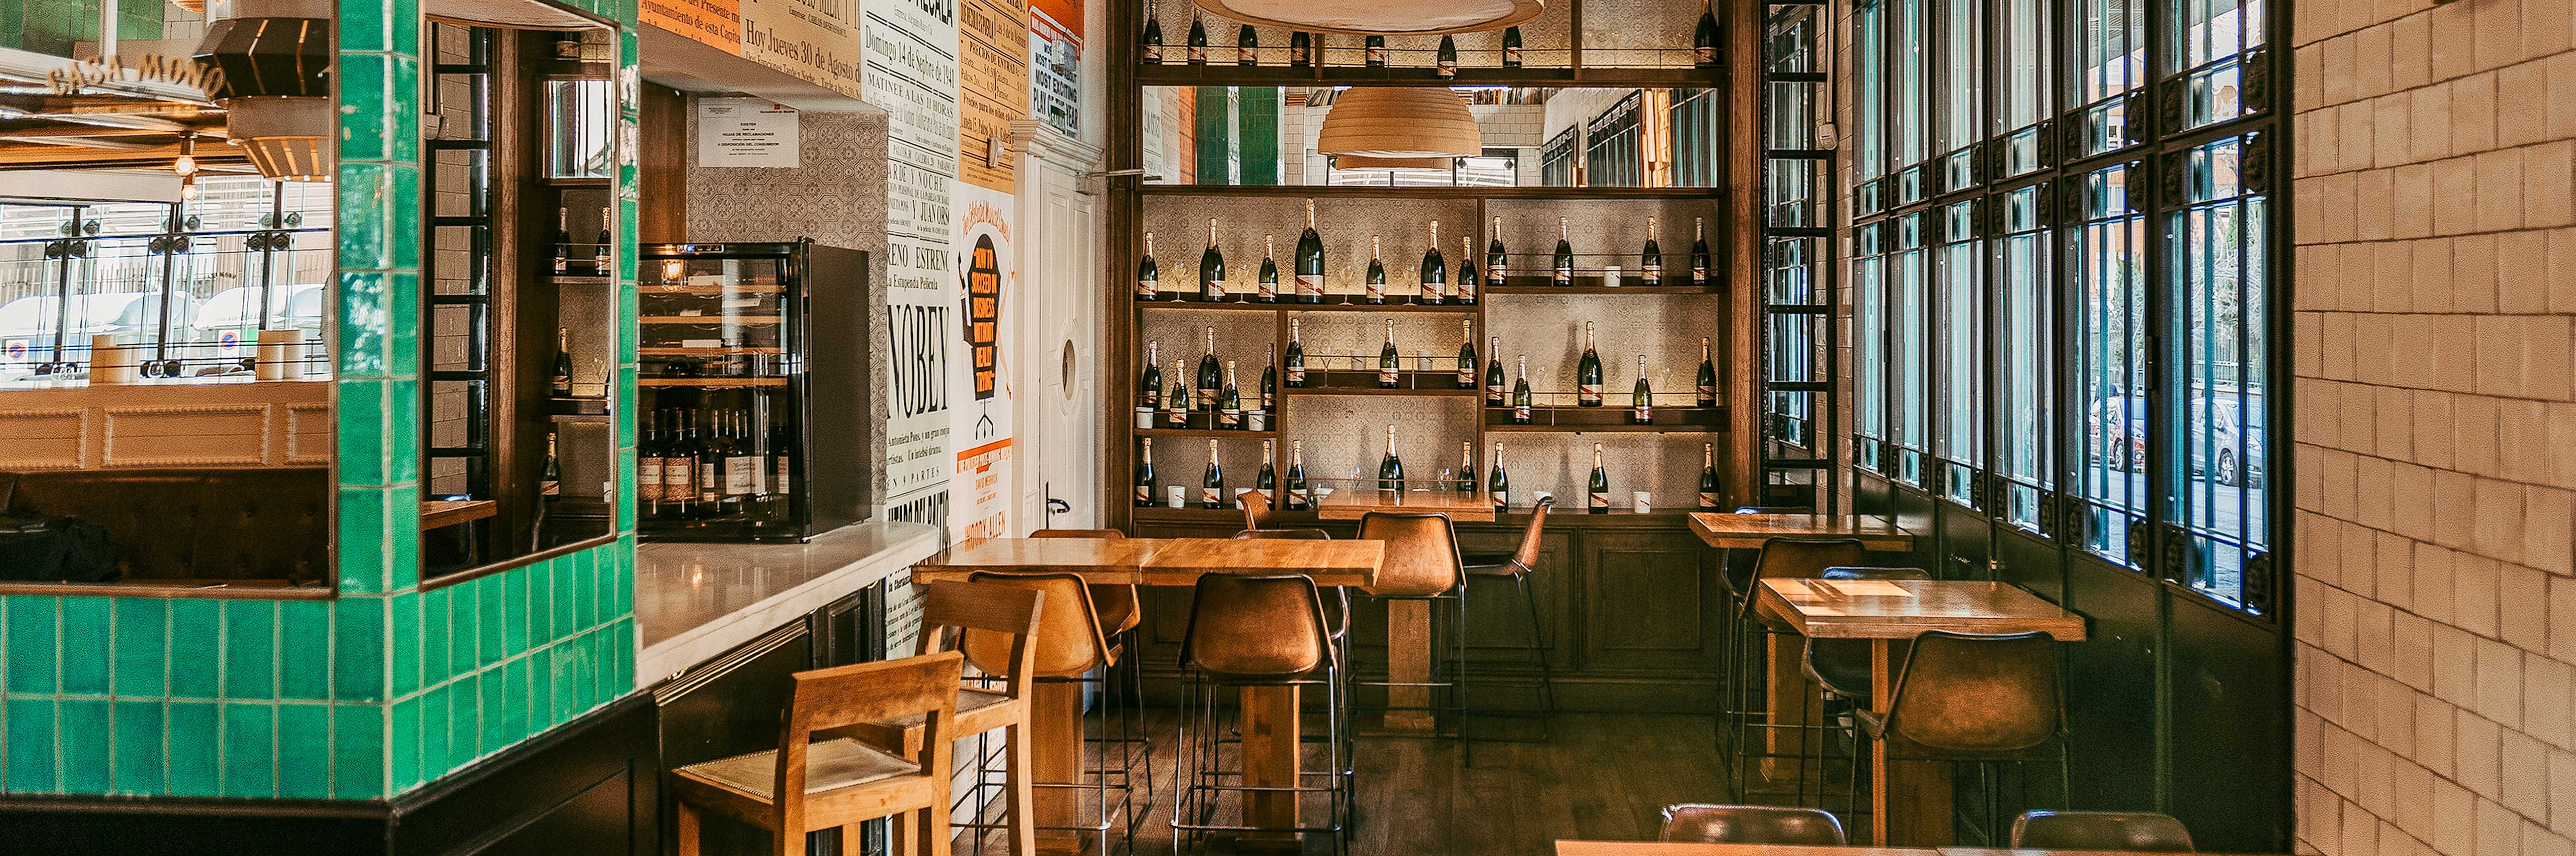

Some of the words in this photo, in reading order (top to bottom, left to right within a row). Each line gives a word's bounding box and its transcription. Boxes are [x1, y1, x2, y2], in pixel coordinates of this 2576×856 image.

[641, 0, 693, 26] Ayuntamiento
[694, 15, 704, 30] de
[705, 22, 719, 36] esta
[745, 18, 766, 53] Hoy
[768, 27, 799, 61] Jueves
[801, 40, 813, 65] 30
[815, 47, 825, 71] de
[827, 51, 853, 81] Agosto
[866, 25, 896, 66] Domingo
[899, 41, 906, 64] 14
[907, 45, 915, 69] de
[935, 60, 941, 83] de
[943, 64, 954, 88] 1941
[970, 41, 991, 62] PRECIOS
[991, 52, 997, 65] DE
[46, 54, 124, 96] CASA
[137, 52, 226, 102] MONO
[1036, 69, 1051, 91] MOST
[1053, 75, 1077, 104] EXCITING
[868, 72, 904, 98] MATINEE
[905, 89, 910, 100] A
[911, 89, 924, 106] LAS
[933, 99, 953, 119] HORAS
[963, 93, 979, 109] Precios
[979, 102, 988, 113] para
[1033, 87, 1047, 116] PLAY
[1066, 102, 1078, 130] YEAR
[911, 168, 915, 185] Y
[912, 200, 917, 220] Y
[920, 201, 936, 223] JUAN
[987, 248, 994, 270] TO
[893, 274, 919, 292] Estupenda
[971, 271, 992, 294] SUCCEED
[992, 273, 997, 294] IN
[973, 296, 995, 318] BUSINESS
[973, 322, 995, 344] WITHOUT
[975, 346, 993, 369] REALLY
[911, 465, 939, 484] PARTES
[964, 518, 987, 540] WOODY
[988, 510, 1006, 540] ALLEN
